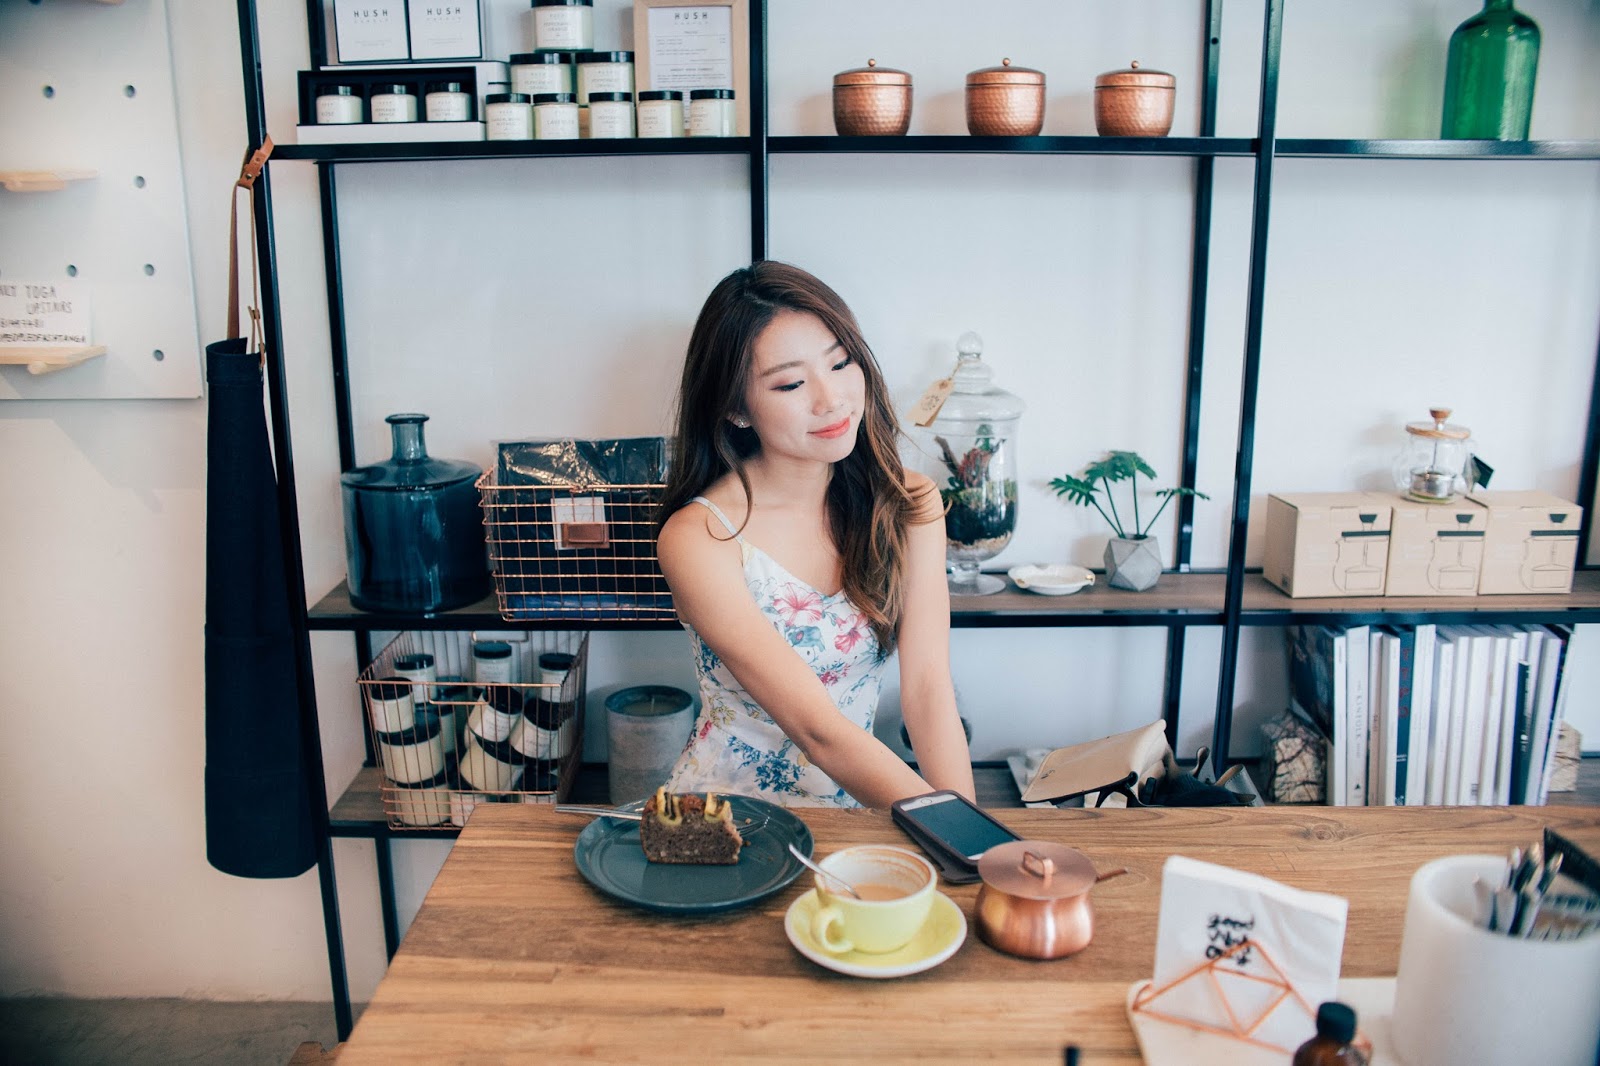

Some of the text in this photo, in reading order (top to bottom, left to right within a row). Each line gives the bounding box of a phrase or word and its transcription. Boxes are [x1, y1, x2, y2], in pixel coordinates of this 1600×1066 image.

[353, 9, 388, 18] HUSH
[426, 7, 461, 15] HUSH
[674, 12, 708, 20] HUSH
[26, 300, 73, 315] UPSTAIRS
[1355, 695, 1363, 740] KINFOLK
